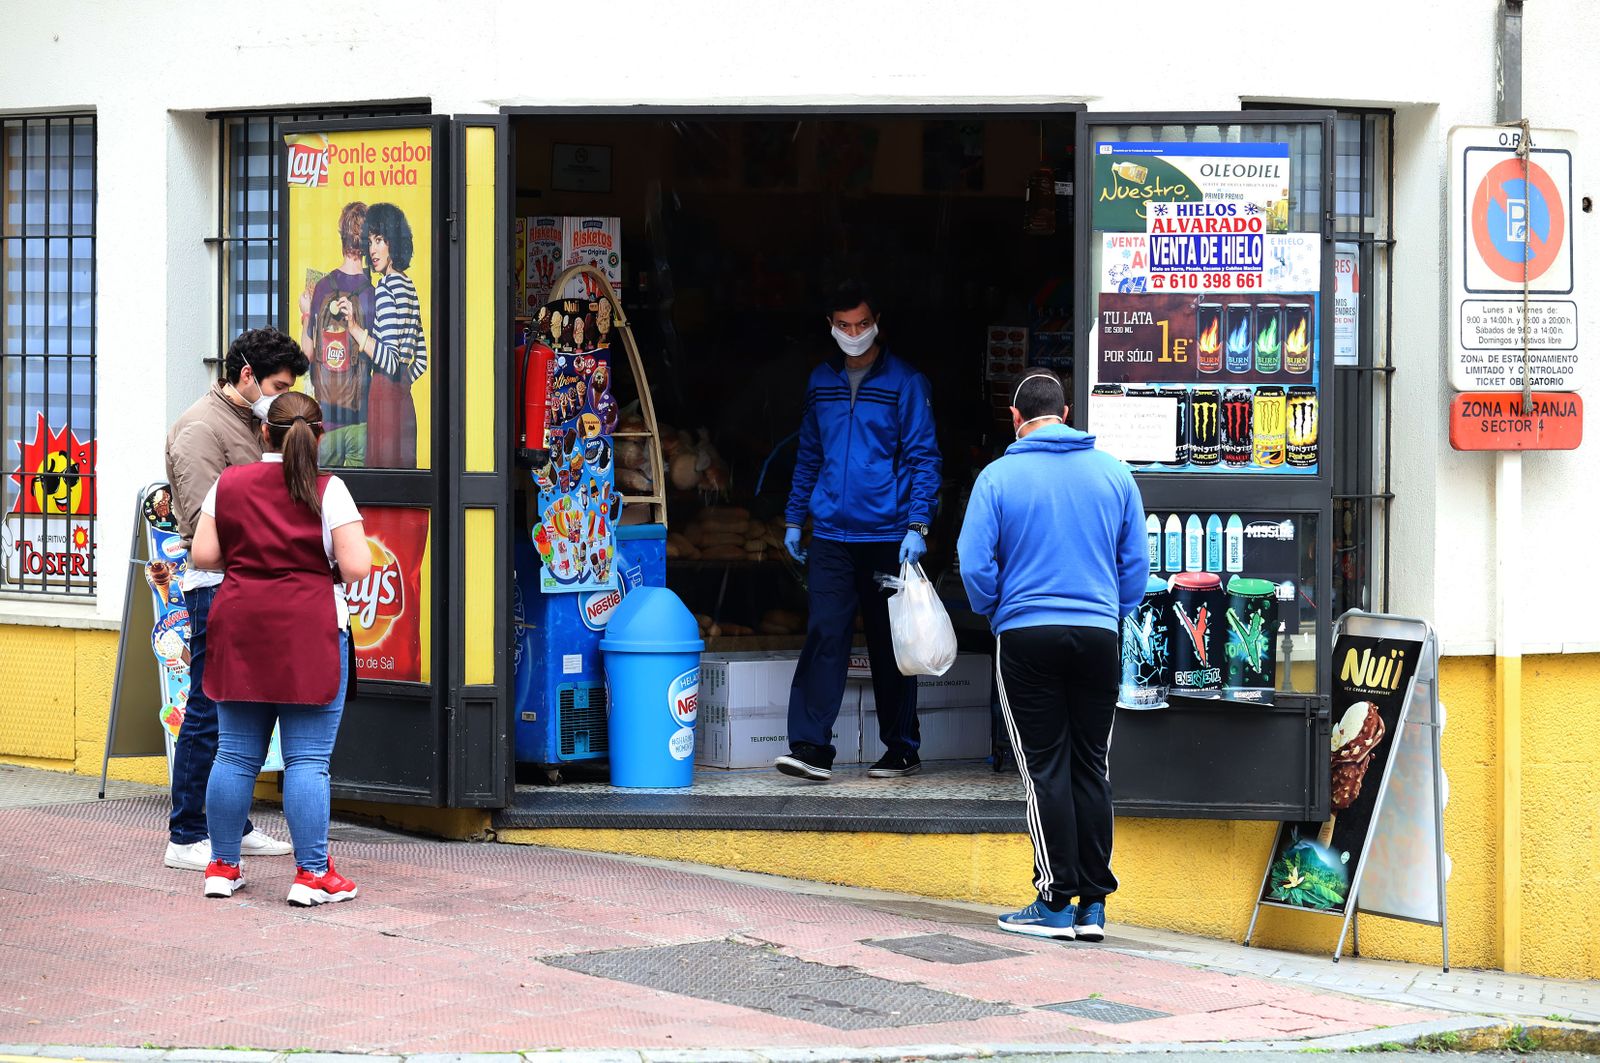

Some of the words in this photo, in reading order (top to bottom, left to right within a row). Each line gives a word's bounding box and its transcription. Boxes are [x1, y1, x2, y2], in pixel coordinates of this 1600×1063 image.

[328, 142, 377, 164] Ponle
[343, 169, 354, 187] a
[360, 165, 375, 187] la
[380, 164, 417, 186] vida
[1200, 163, 1280, 178] OLEODIEL
[1099, 175, 1186, 202] Nuestro
[1177, 203, 1237, 217] HIELOS
[1152, 217, 1262, 233] ALVARADO
[1111, 237, 1146, 248] VENTA
[1277, 238, 1304, 246] HIELO
[1152, 236, 1199, 266] VENTA
[1201, 236, 1218, 266] DE
[1221, 236, 1262, 266] HIELO
[1335, 259, 1351, 273] RES
[1170, 273, 1198, 289] 610
[1203, 273, 1231, 289] 398
[1237, 273, 1262, 289] 661
[1482, 306, 1504, 314] Lunes
[1516, 306, 1543, 314] Virnes
[1104, 311, 1120, 324] TU
[1123, 312, 1154, 325] LATA
[1507, 326, 1516, 334] de
[1478, 336, 1512, 346] Domingos
[1520, 336, 1546, 344] fstivos
[1548, 336, 1562, 345] libre
[1104, 350, 1125, 363] POR
[1127, 346, 1153, 362] SÓLO
[1460, 354, 1484, 363] ZONA
[1488, 355, 1499, 363] DE
[1465, 366, 1505, 375] LIMITADO
[1508, 366, 1514, 375] Y
[1518, 366, 1574, 375] CNTROLADO
[1476, 377, 1506, 386] TICKET
[1509, 377, 1564, 386] OBLGATORIO
[1461, 401, 1503, 417] ZONA
[1481, 419, 1532, 433] SECTOR
[1538, 418, 1545, 432] 4
[355, 655, 364, 669] to
[366, 656, 378, 669] de
[380, 656, 395, 671] Sal
